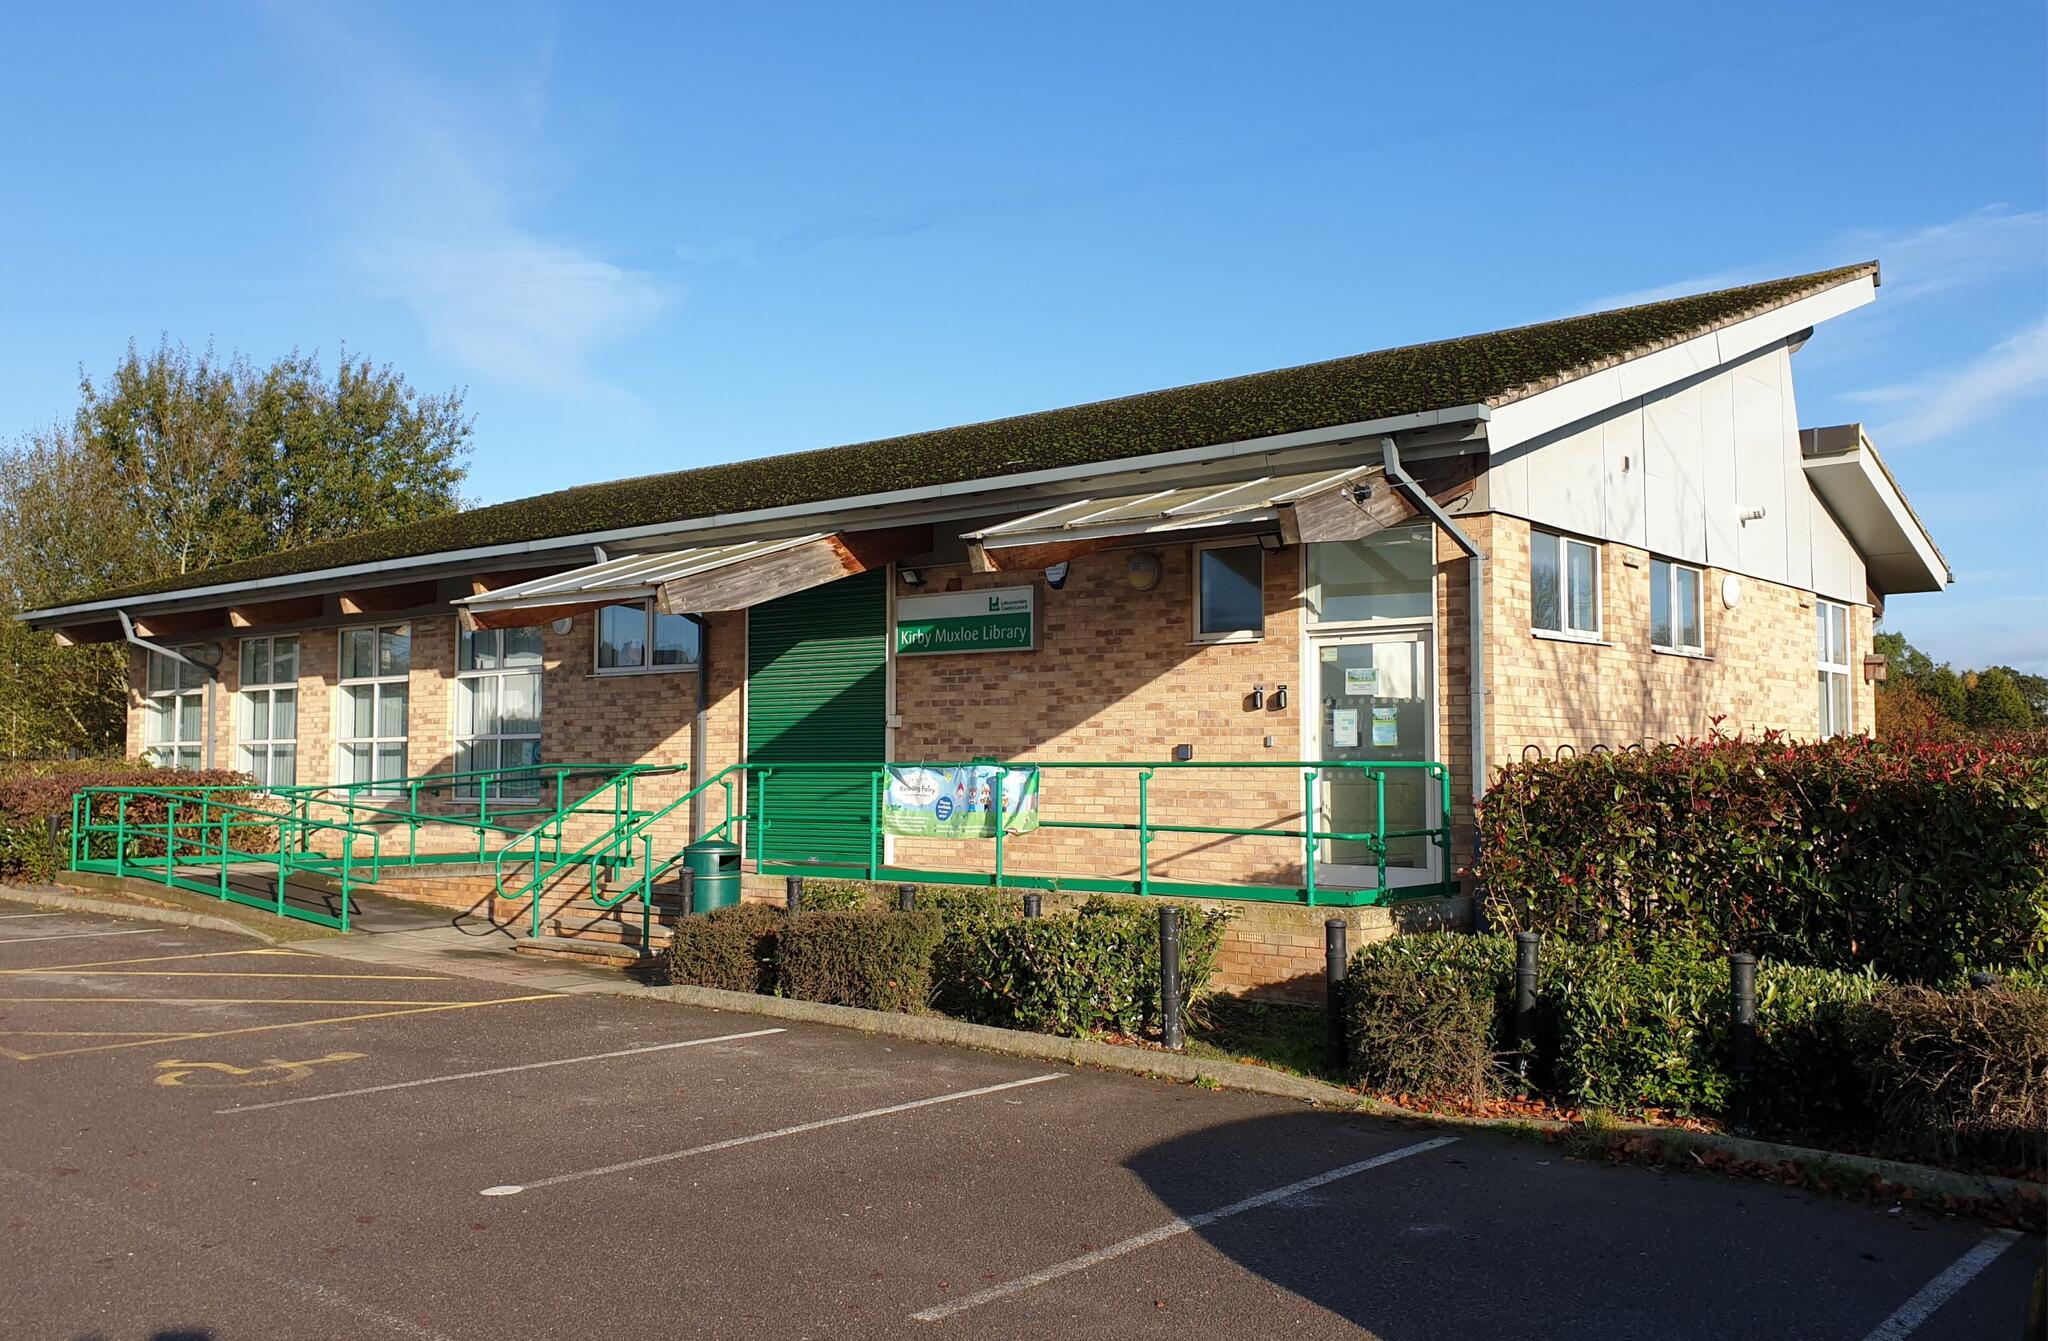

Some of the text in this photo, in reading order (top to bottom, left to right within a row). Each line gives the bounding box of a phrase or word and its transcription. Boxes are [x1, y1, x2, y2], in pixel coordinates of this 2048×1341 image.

[901, 624, 1027, 647] Kirby Muxloe Library
